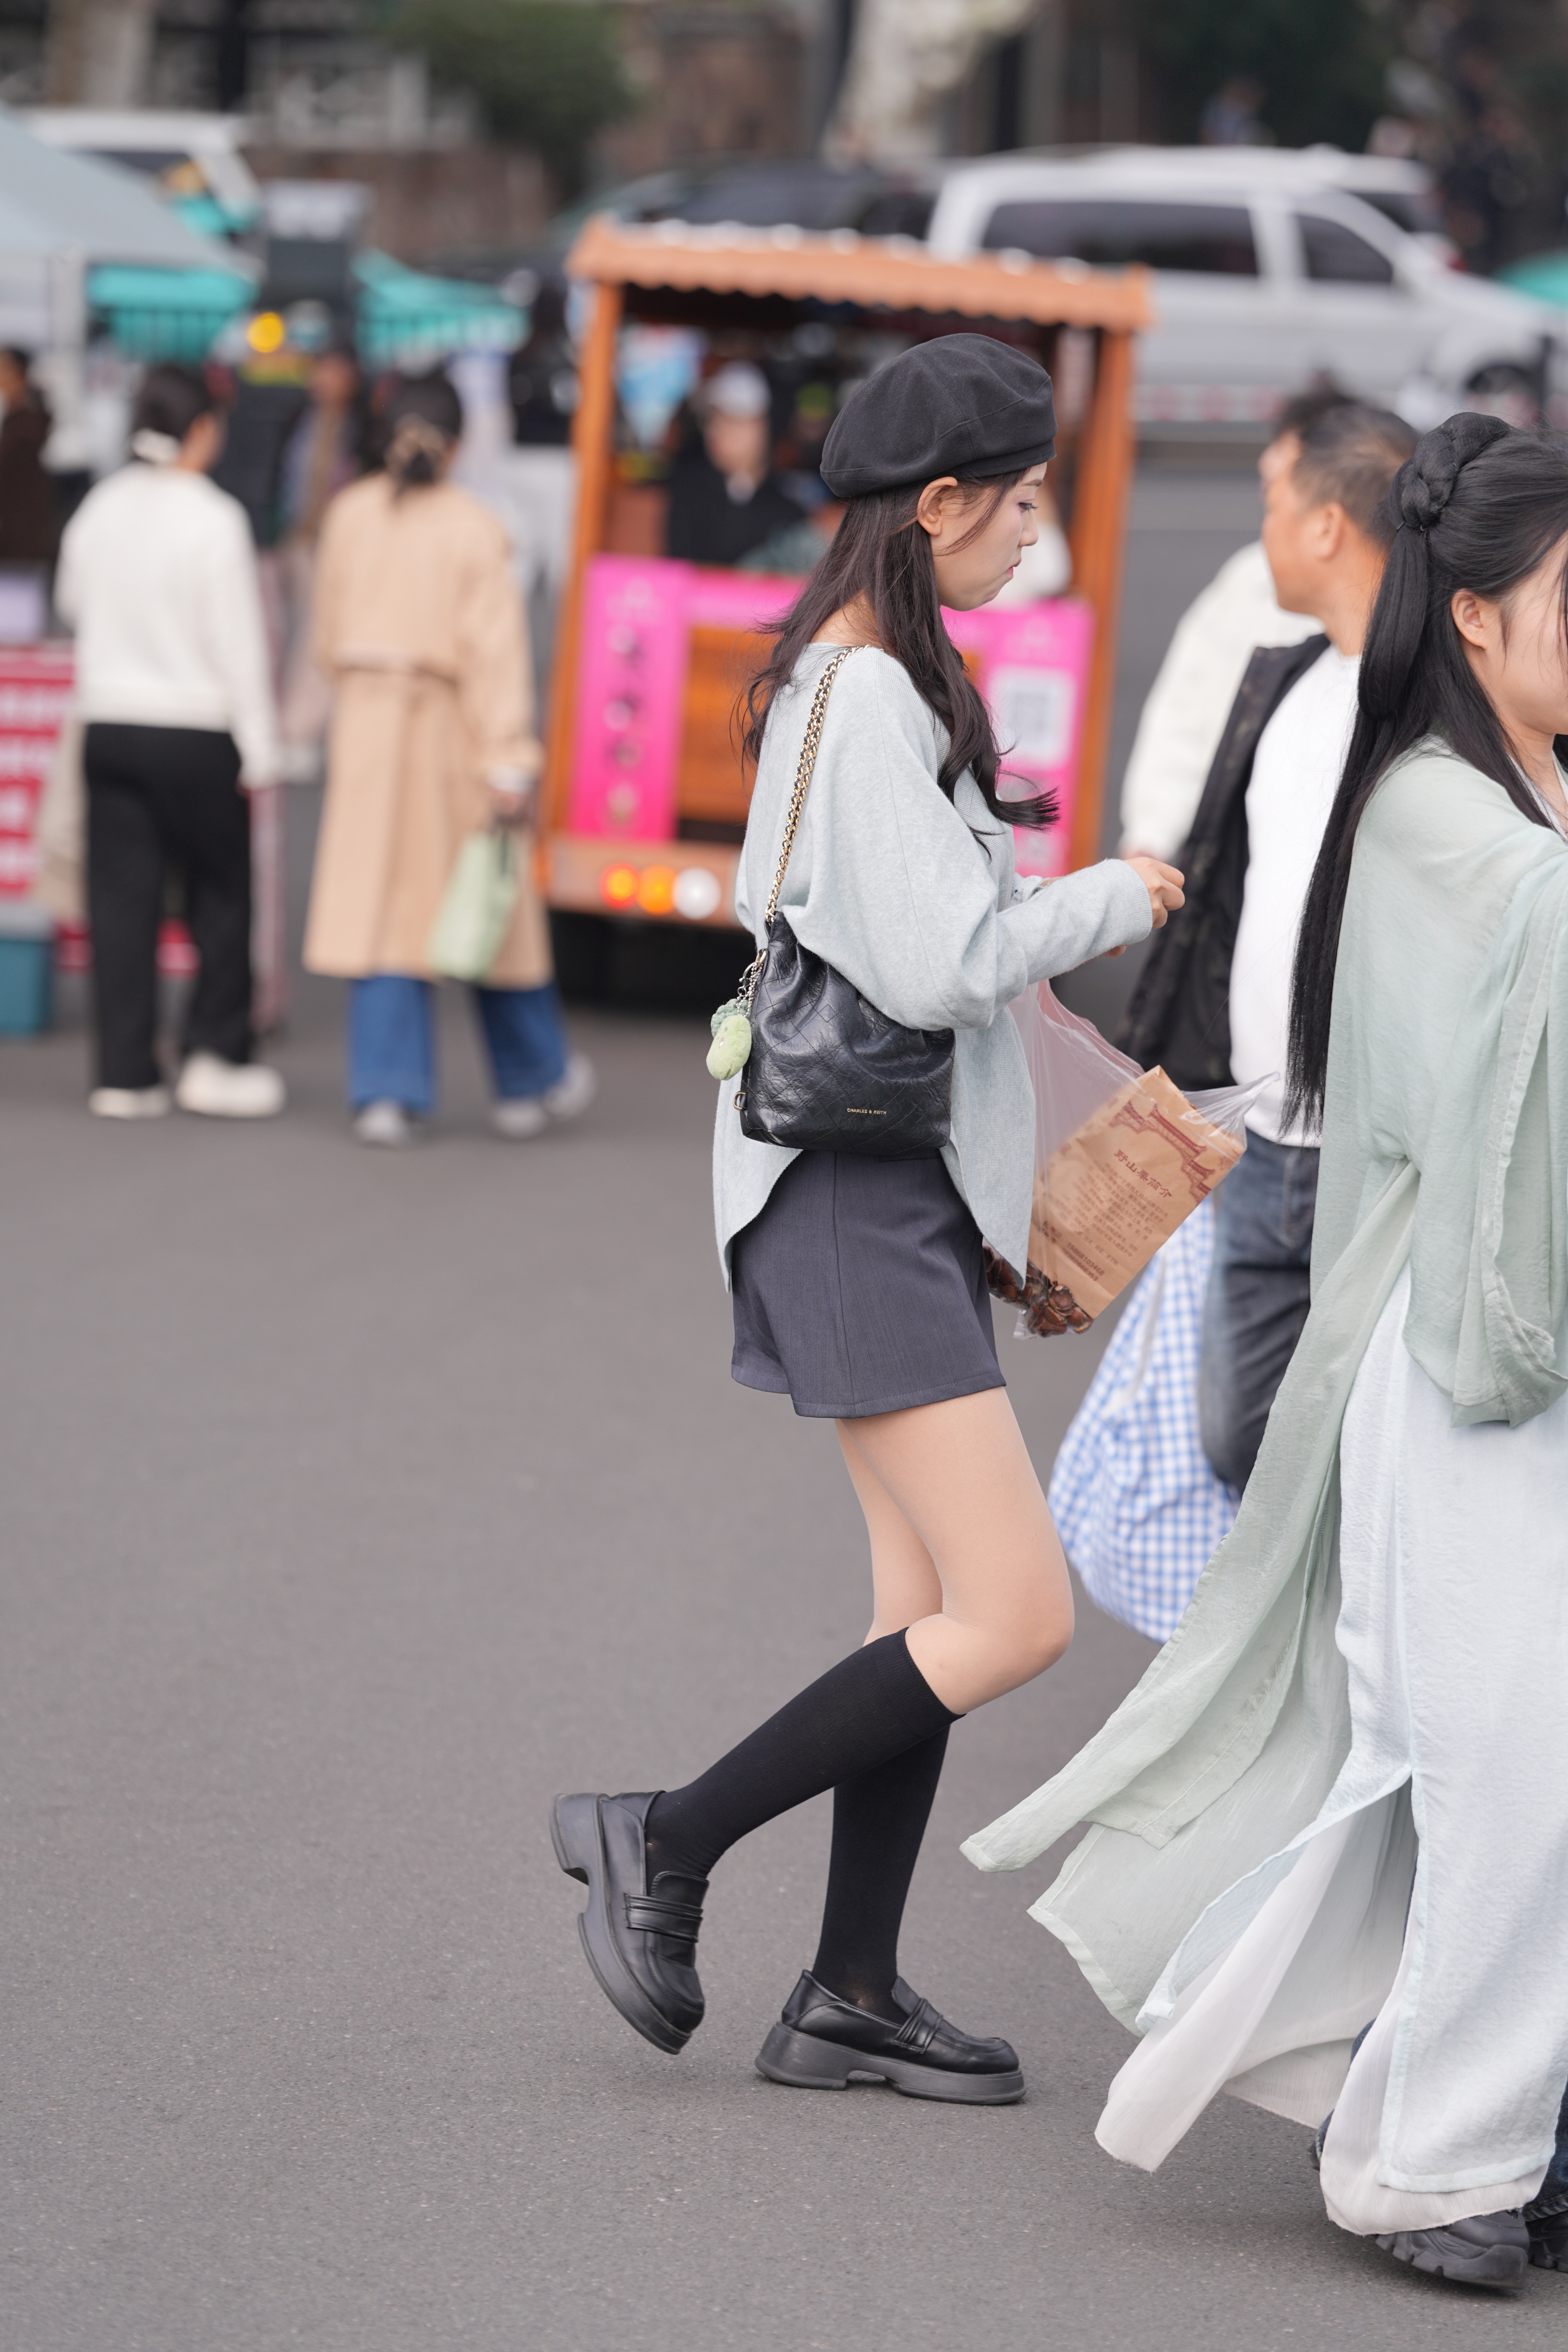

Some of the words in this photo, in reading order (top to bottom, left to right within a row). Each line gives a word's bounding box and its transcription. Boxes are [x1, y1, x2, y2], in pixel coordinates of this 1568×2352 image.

[1114, 1149, 1172, 1198] 野山栗简介
[1066, 1242, 1105, 1276] 15868103468
